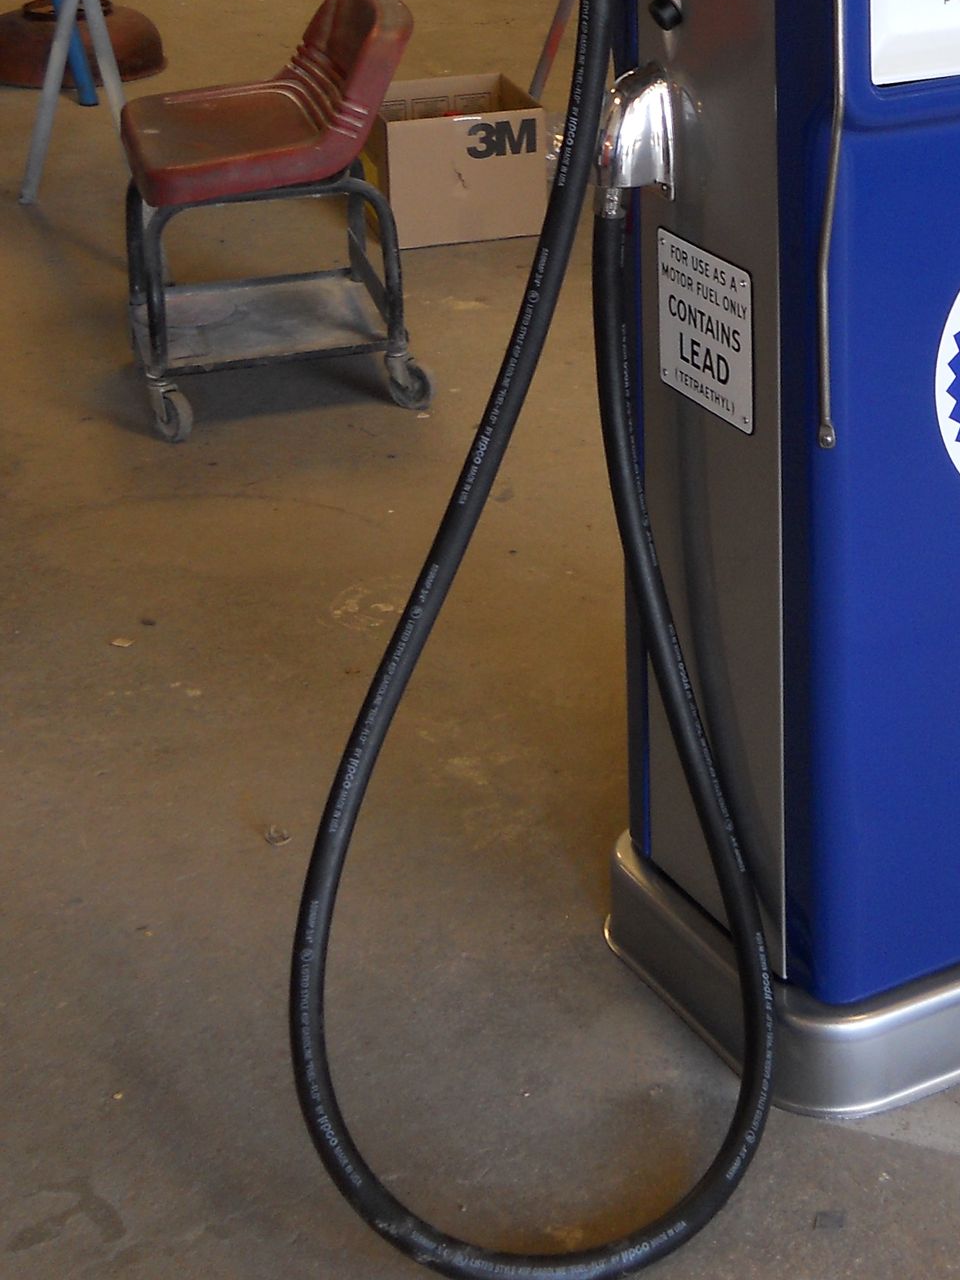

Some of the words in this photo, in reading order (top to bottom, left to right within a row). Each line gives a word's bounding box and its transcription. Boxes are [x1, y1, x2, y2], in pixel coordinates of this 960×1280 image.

[467, 118, 537, 159] 3M
[662, 262, 694, 293] MOTOR
[697, 282, 720, 307] FUEL
[723, 296, 748, 321] ONLY
[670, 244, 688, 267] FOR
[692, 257, 710, 278] USE
[713, 267, 727, 287] AS
[729, 277, 738, 293] A
[668, 294, 742, 354] CONTAINS
[678, 331, 730, 386] LEAD
[674, 367, 736, 416] (TETRAETHYL)
